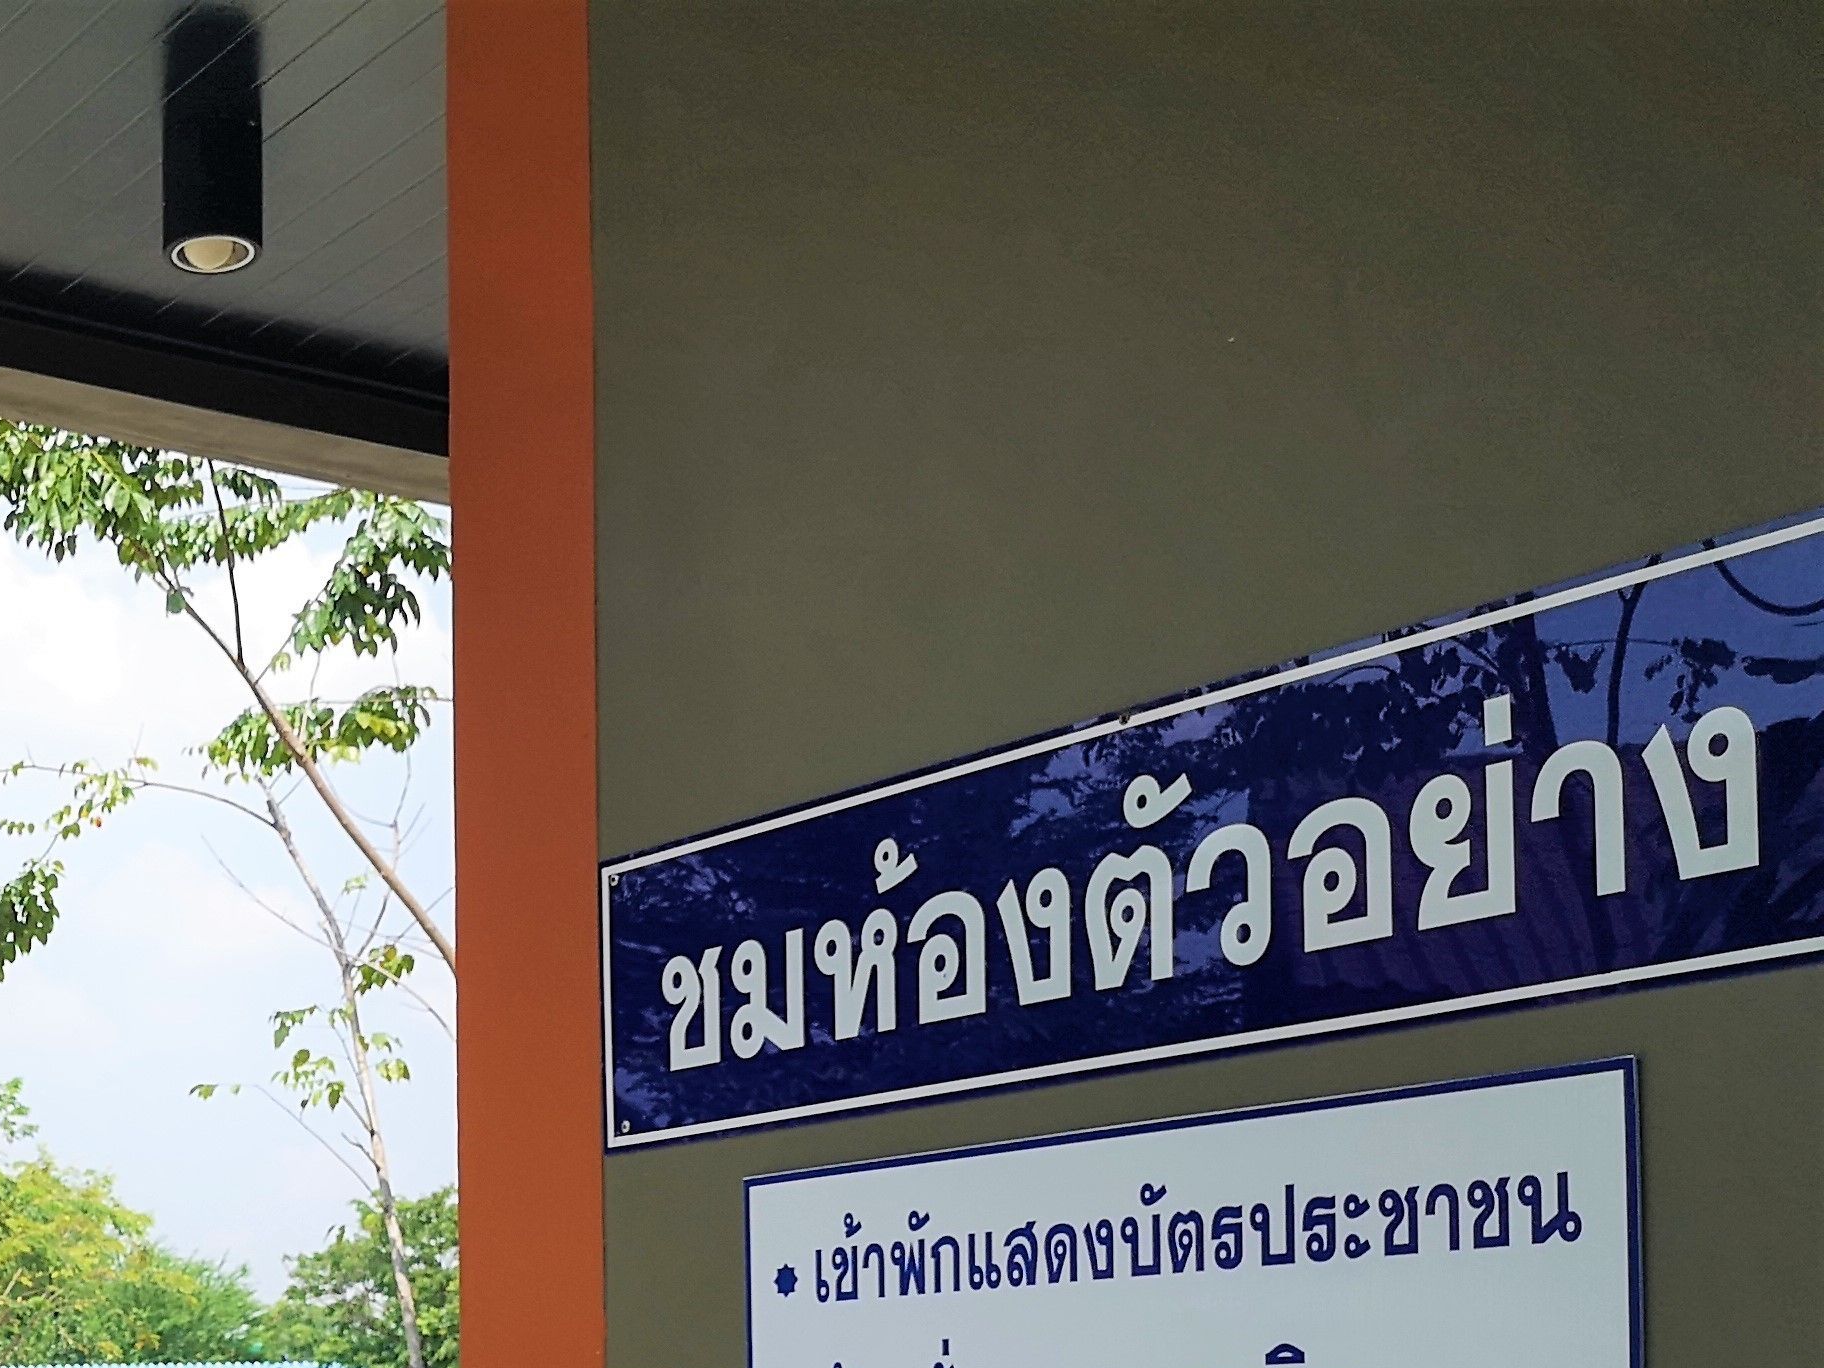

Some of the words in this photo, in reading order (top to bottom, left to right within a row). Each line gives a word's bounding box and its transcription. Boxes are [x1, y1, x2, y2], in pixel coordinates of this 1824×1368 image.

[661, 692, 1762, 1073] ชมห้องตัวอย่าง
[815, 1170, 1583, 1304] เข้าพักแสดงบัตรประชาชน
